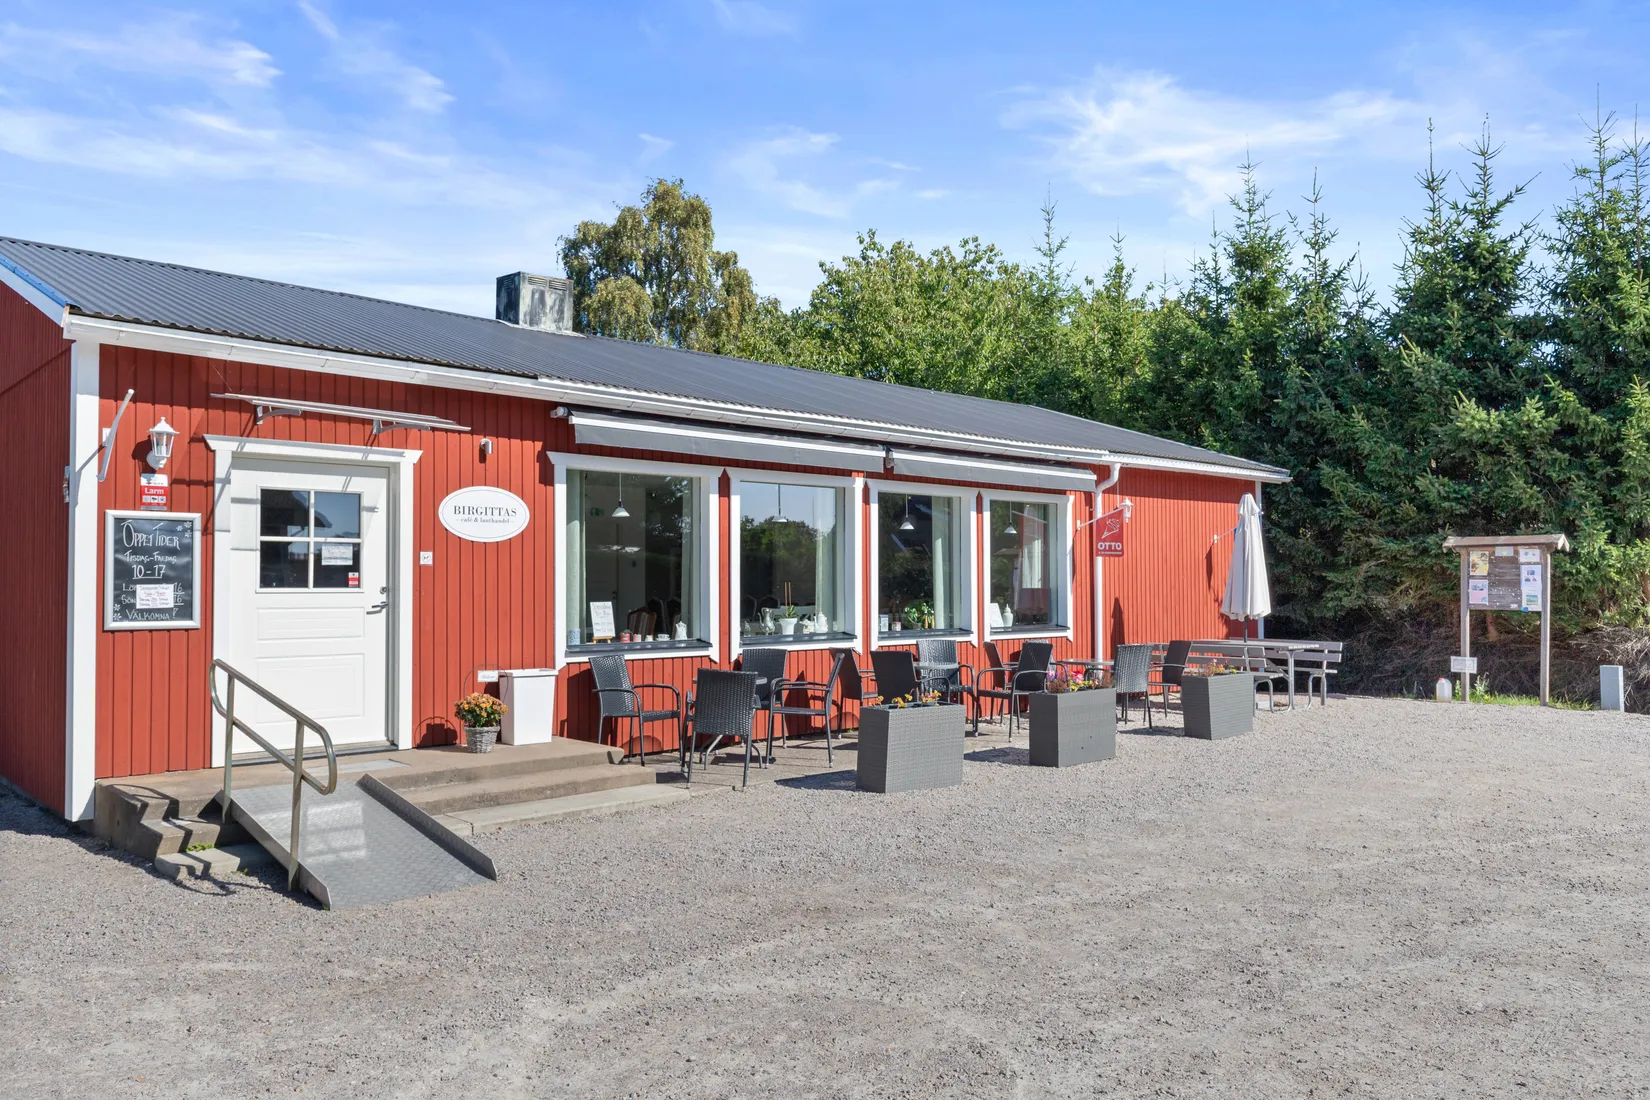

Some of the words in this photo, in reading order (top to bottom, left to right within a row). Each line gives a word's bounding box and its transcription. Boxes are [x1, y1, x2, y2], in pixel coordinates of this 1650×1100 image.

[453, 505, 517, 517] BIRGITTAS
[153, 522, 180, 550] TIDER
[1097, 542, 1122, 550] OTTO
